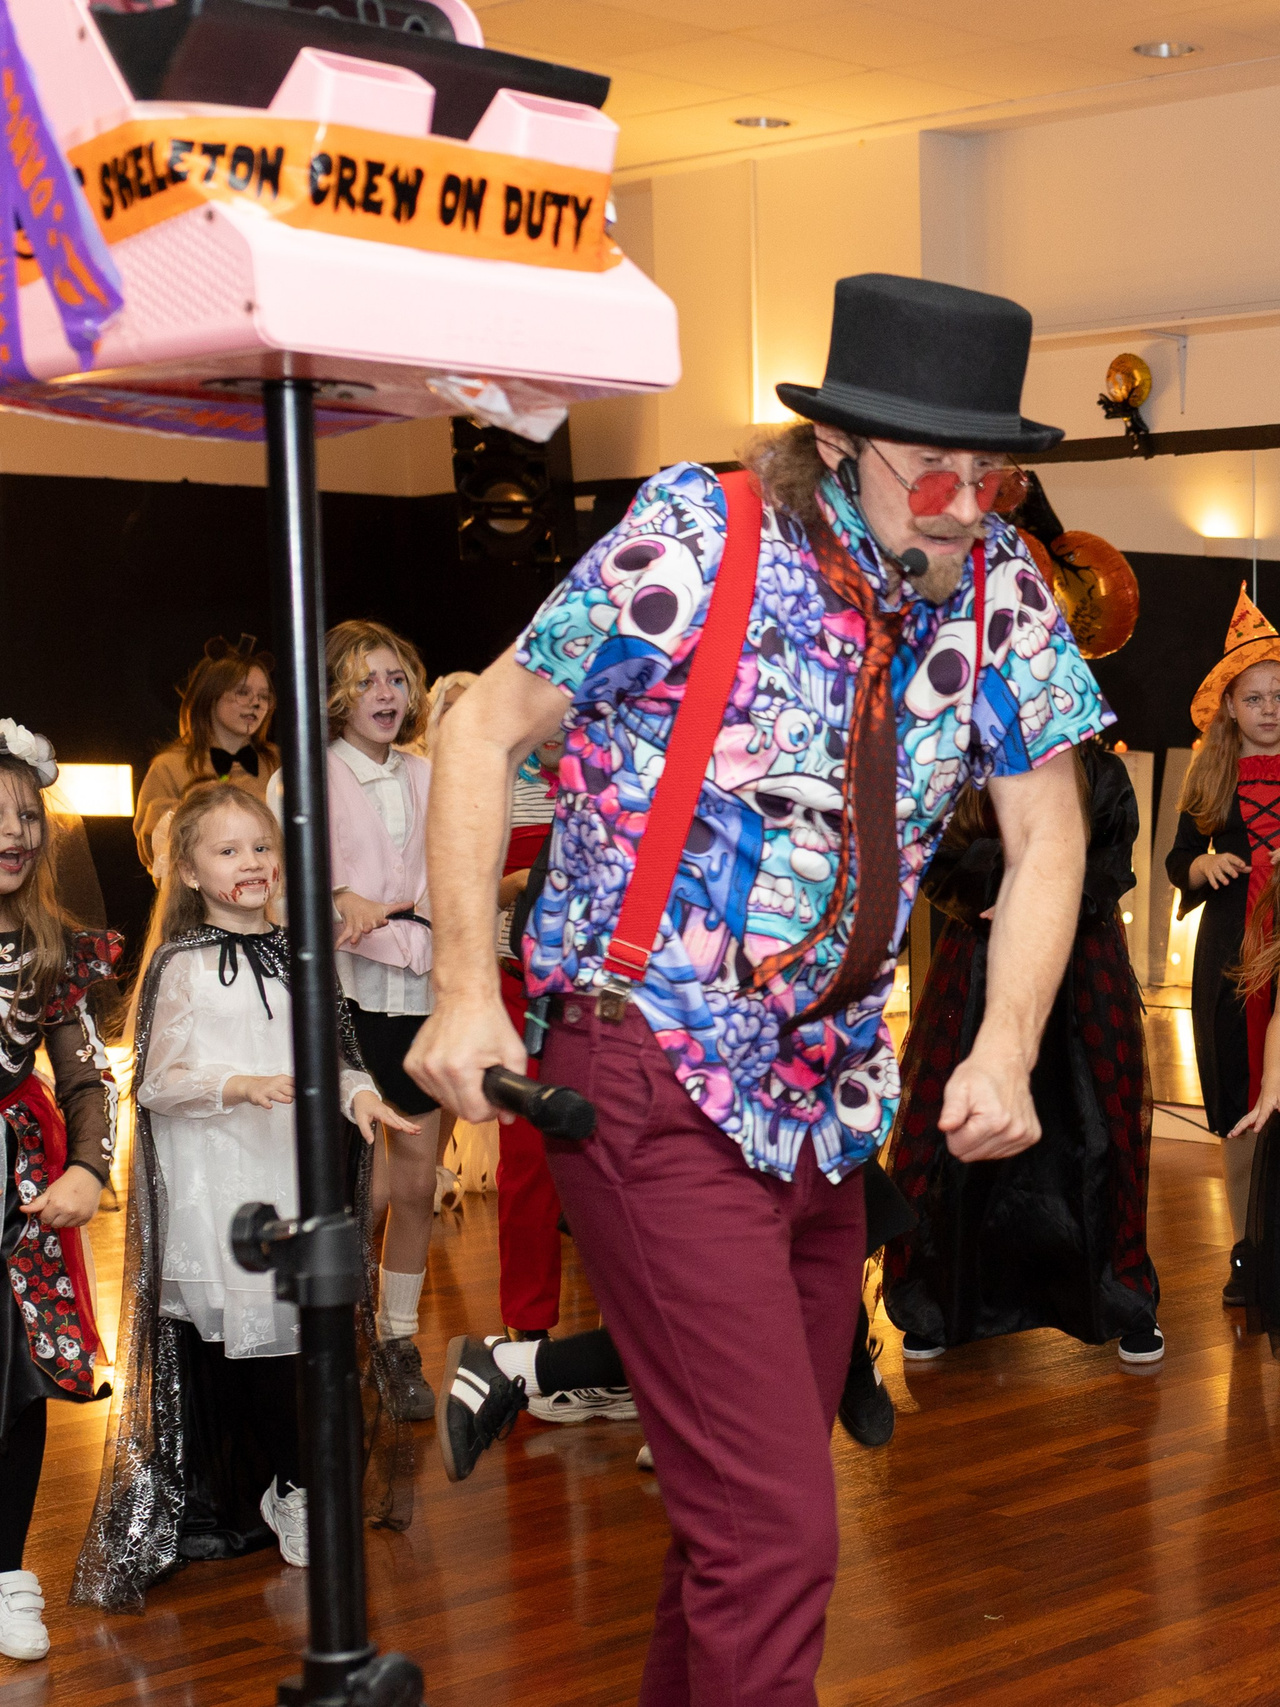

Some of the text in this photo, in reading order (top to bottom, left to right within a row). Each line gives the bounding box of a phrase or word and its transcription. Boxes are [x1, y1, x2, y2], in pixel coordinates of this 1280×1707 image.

[100, 138, 593, 252] SKELETON CREW ON DUTY
